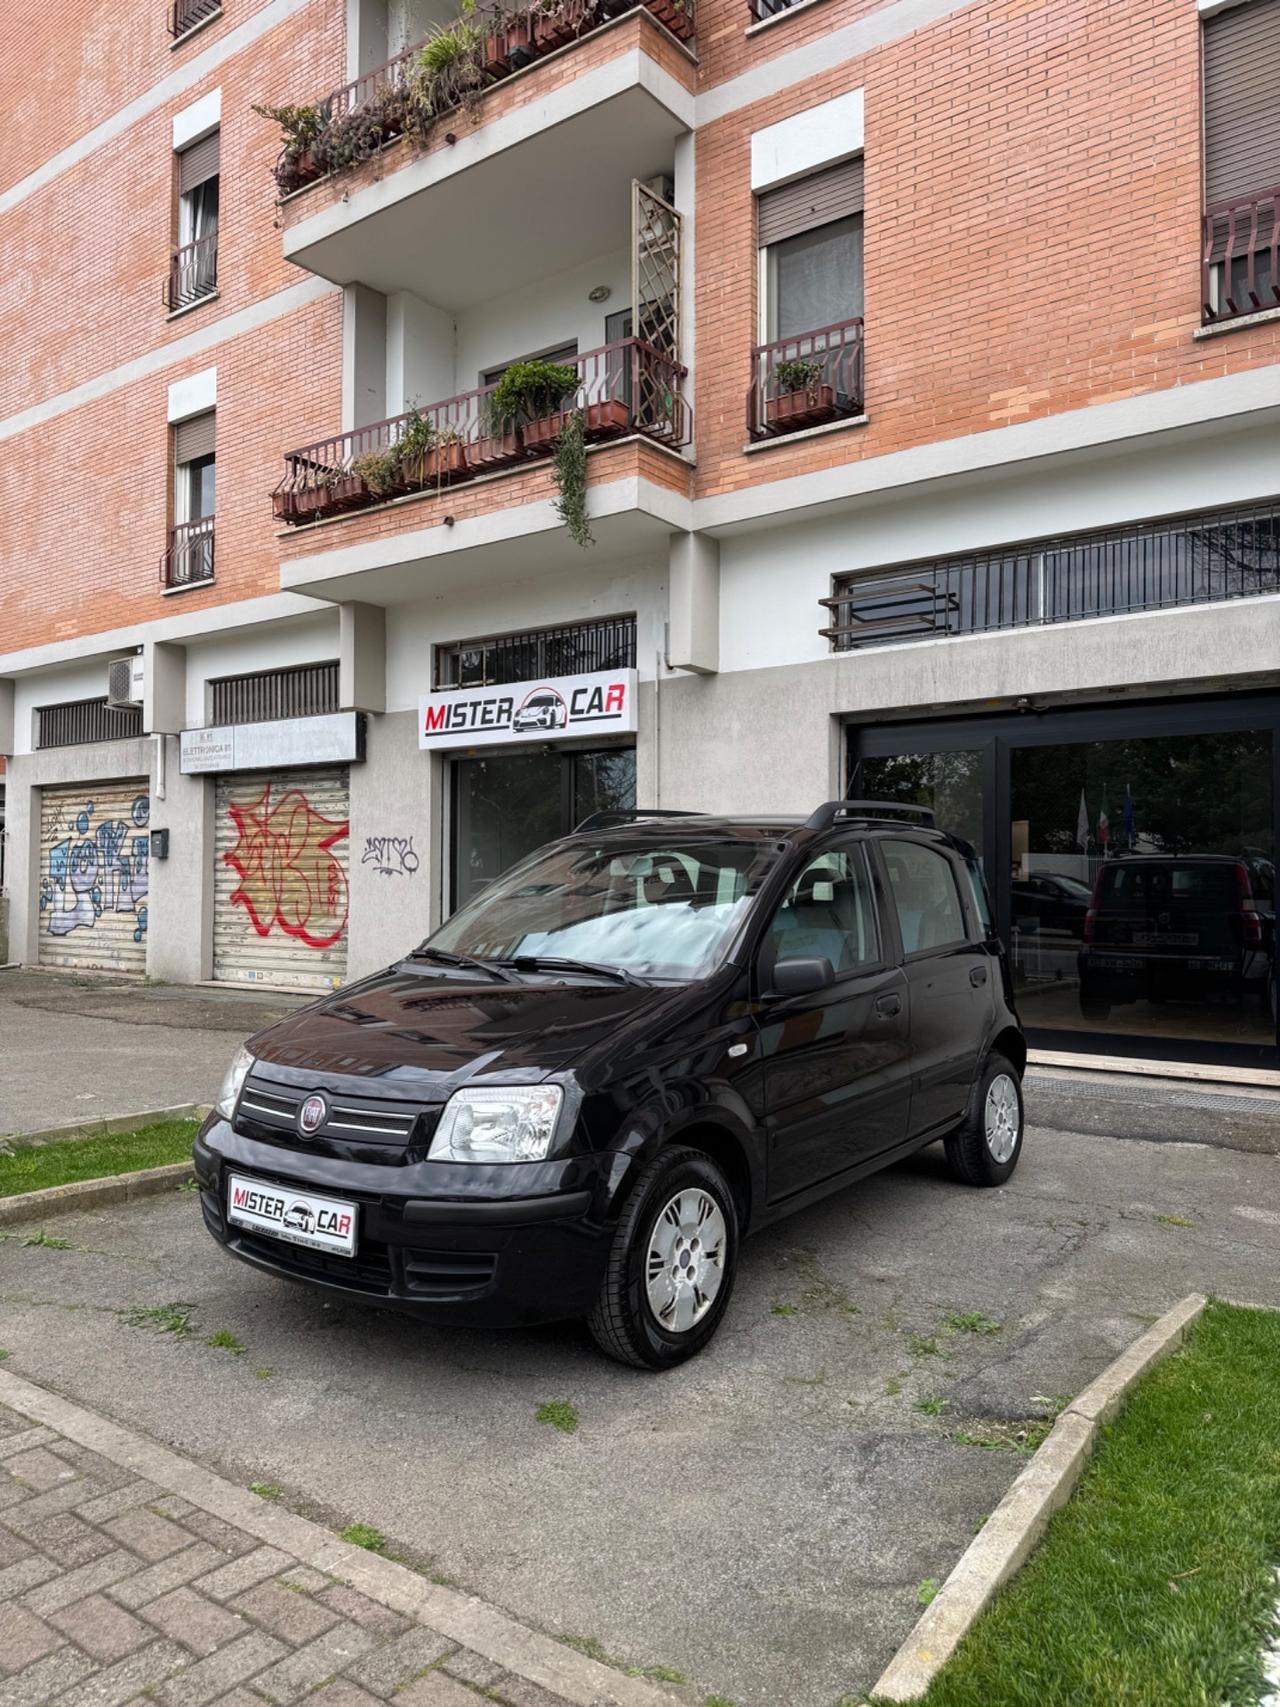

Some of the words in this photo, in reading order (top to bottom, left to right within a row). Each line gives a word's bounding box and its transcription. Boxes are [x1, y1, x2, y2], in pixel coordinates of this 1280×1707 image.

[425, 697, 514, 731] MISTER
[569, 684, 625, 716] CAR
[233, 1187, 285, 1218] MISTER
[316, 1209, 352, 1235] CAR
